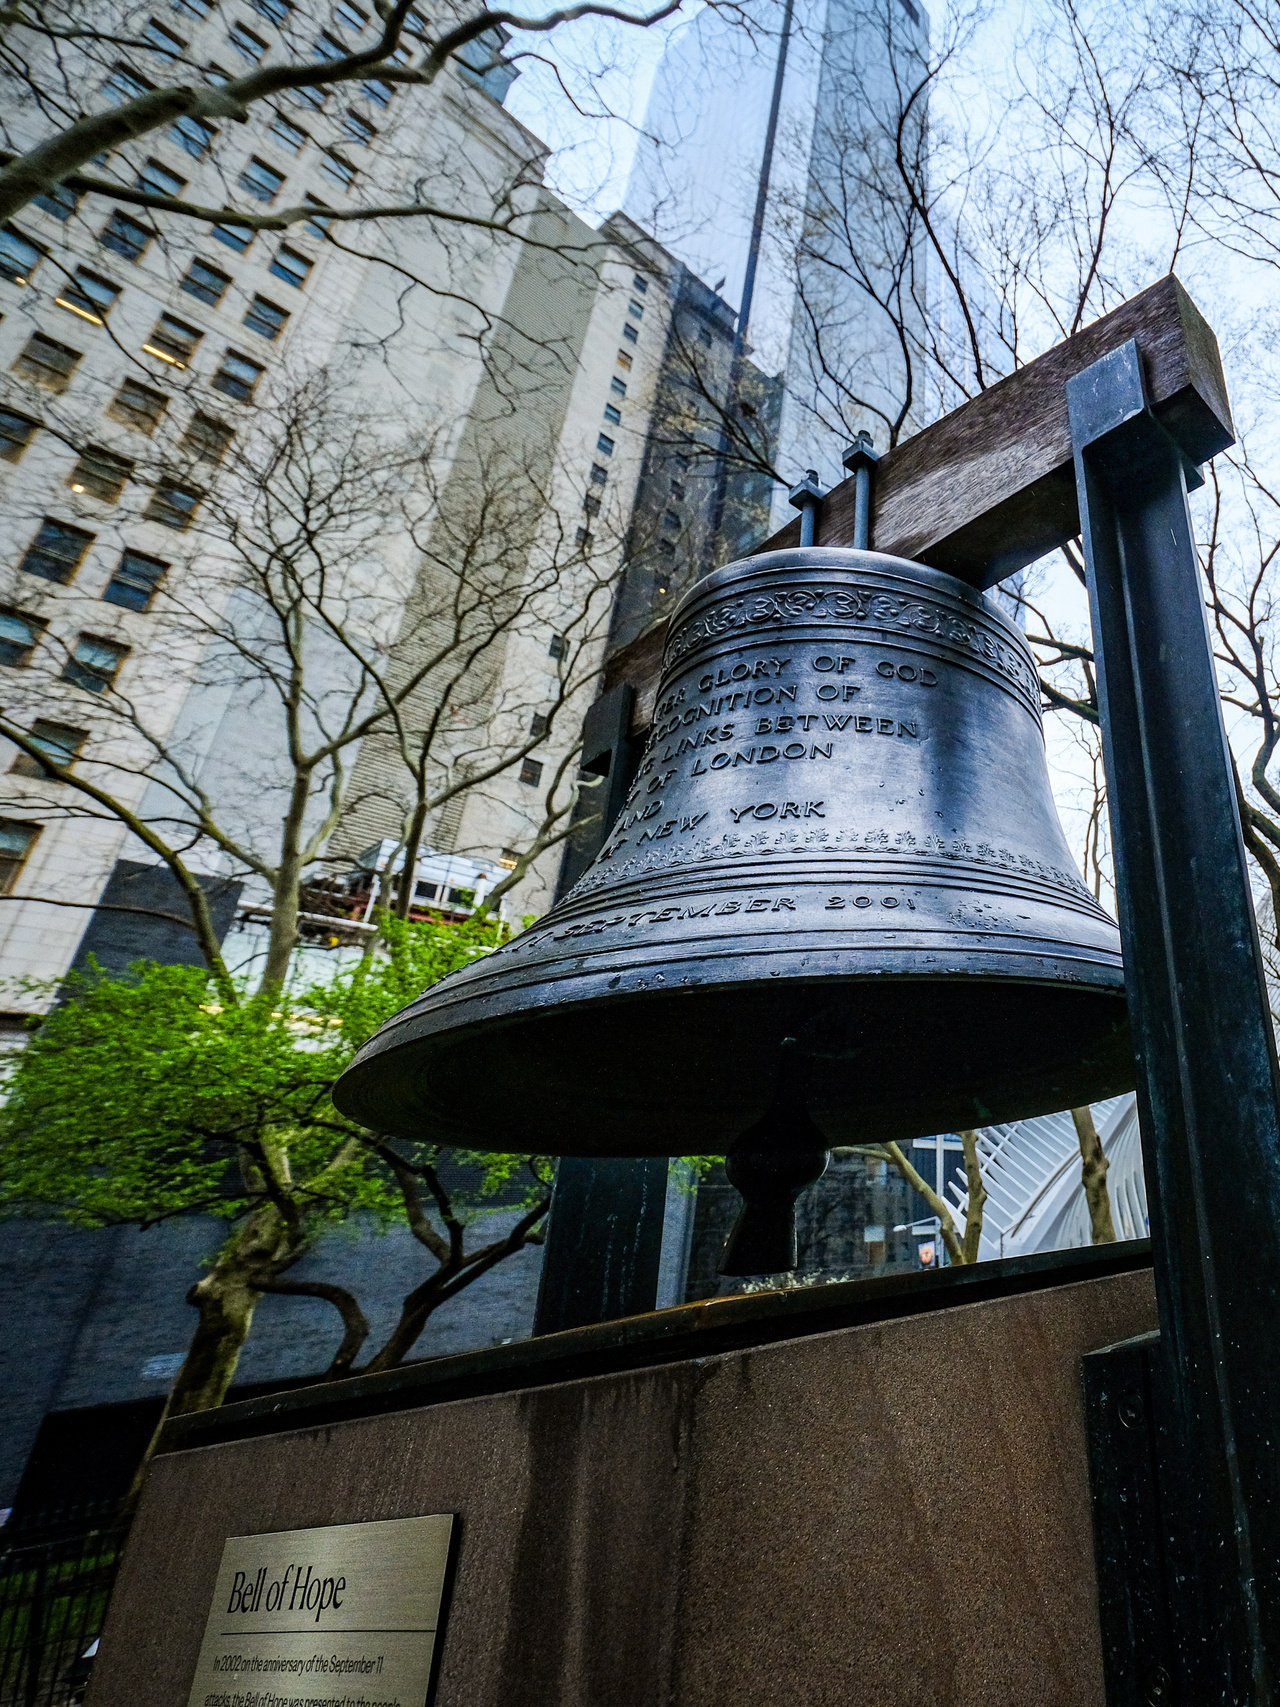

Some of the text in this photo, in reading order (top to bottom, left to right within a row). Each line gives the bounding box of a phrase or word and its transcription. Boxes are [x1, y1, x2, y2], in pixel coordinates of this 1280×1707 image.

[698, 657, 792, 692] GLORY
[813, 656, 856, 674] OF
[876, 661, 938, 686] GOD
[816, 684, 861, 702] OF
[661, 714, 917, 763] LINKS BETWEEN
[647, 768, 677, 794] OF
[691, 742, 833, 777] LONDON
[615, 800, 665, 837] AND
[636, 812, 709, 846] NEW
[730, 801, 825, 823] YORK
[553, 898, 796, 941] SEPTEMBER
[824, 896, 916, 910] 2001
[227, 1564, 346, 1622] Bell of Hope
[213, 1655, 384, 1676] In 2002 on the anniversary of the September 11
